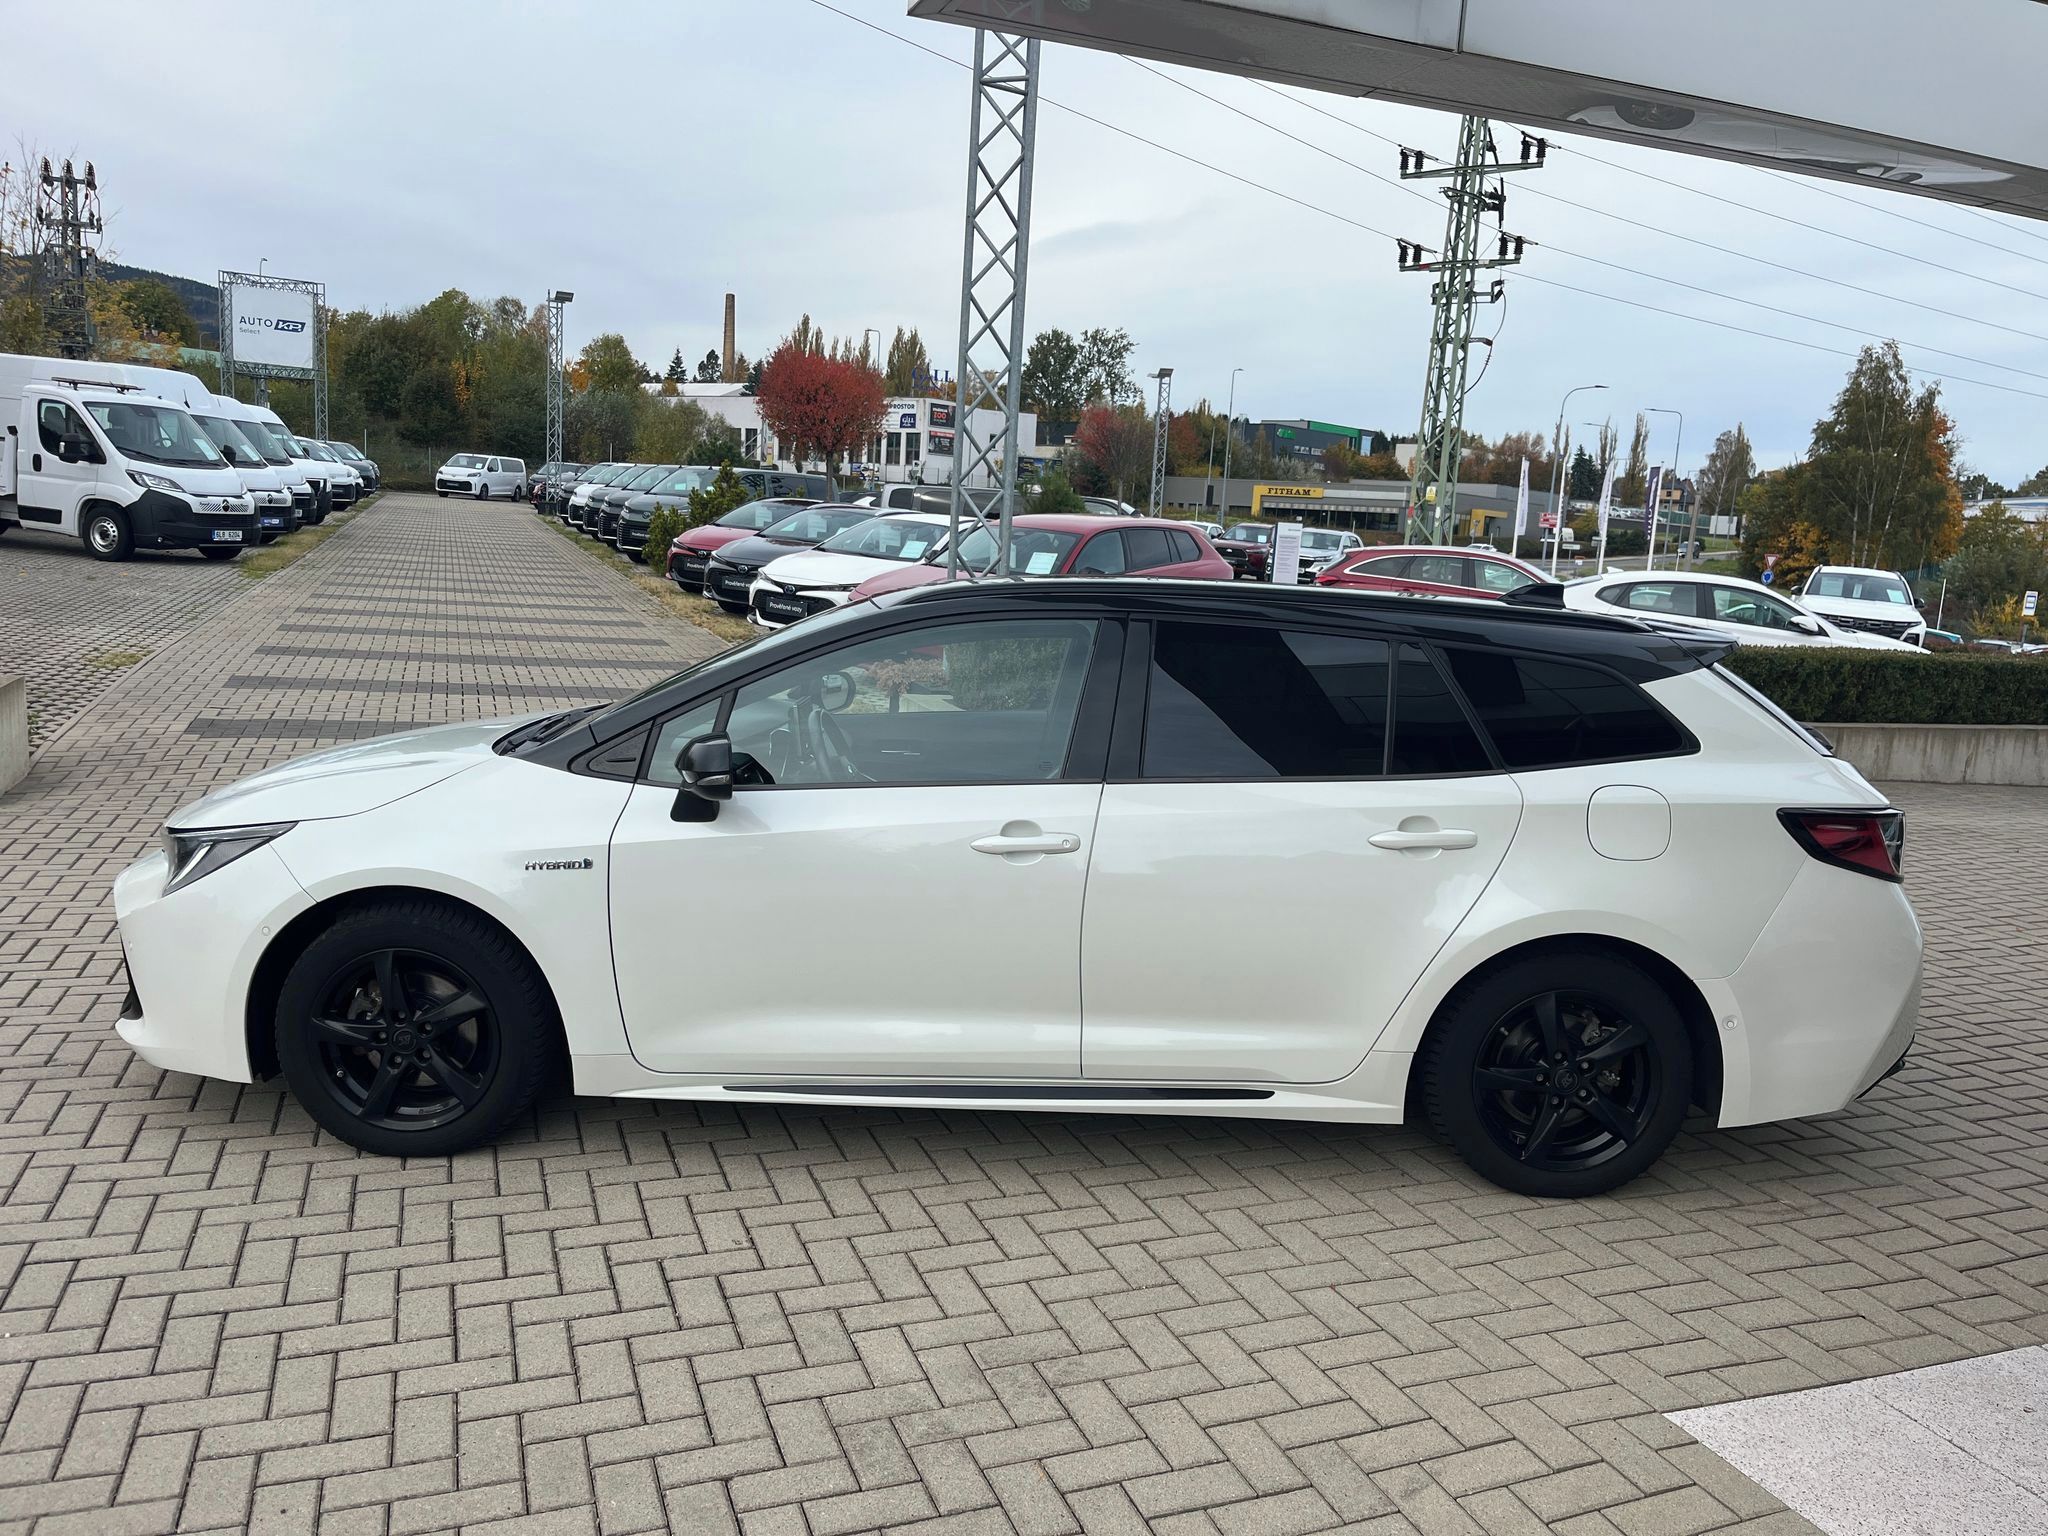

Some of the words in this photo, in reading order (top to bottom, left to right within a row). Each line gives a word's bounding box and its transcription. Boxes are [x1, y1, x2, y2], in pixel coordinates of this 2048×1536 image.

[239, 316, 273, 328] AUTO
[239, 327, 261, 335] Select
[1267, 487, 1312, 496] FITHAM
[791, 606, 803, 614] vozy
[524, 860, 583, 871] HYBRID
